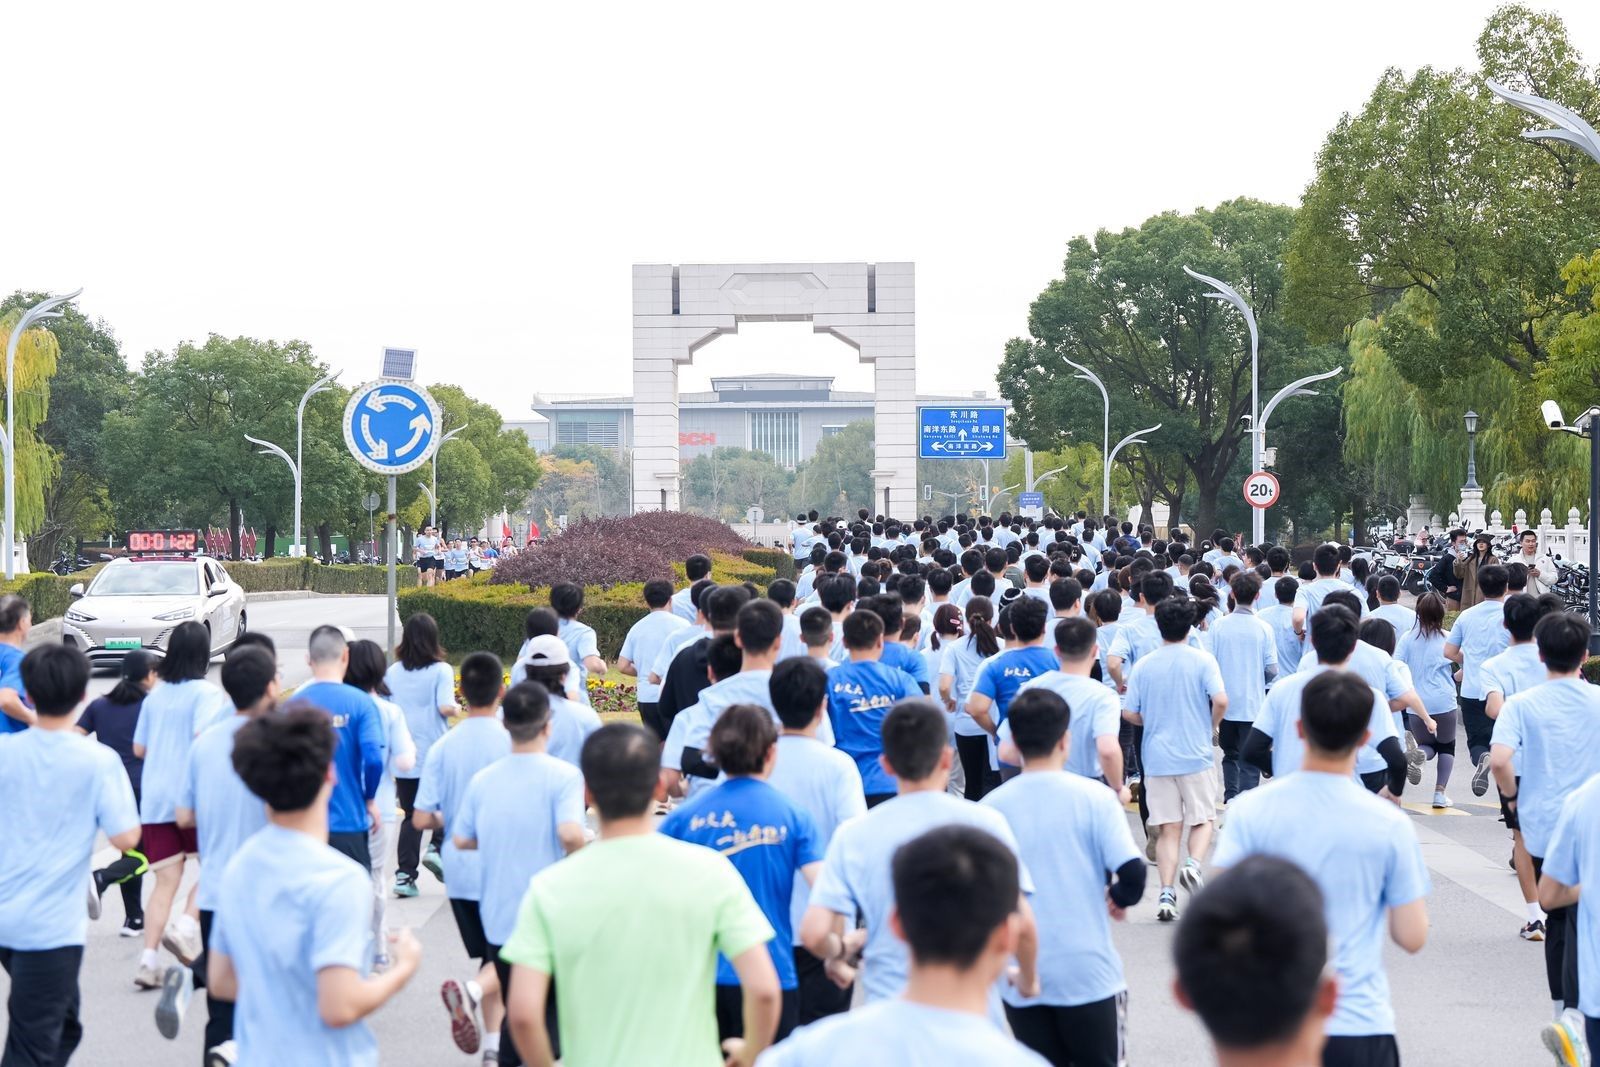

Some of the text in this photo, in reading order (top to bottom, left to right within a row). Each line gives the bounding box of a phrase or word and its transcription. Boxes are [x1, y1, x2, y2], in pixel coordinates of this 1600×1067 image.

[950, 410, 978, 418] 东川路
[923, 425, 956, 433] 南洋东路
[1250, 484, 1272, 496] 20t
[130, 533, 195, 550] 00:01:22
